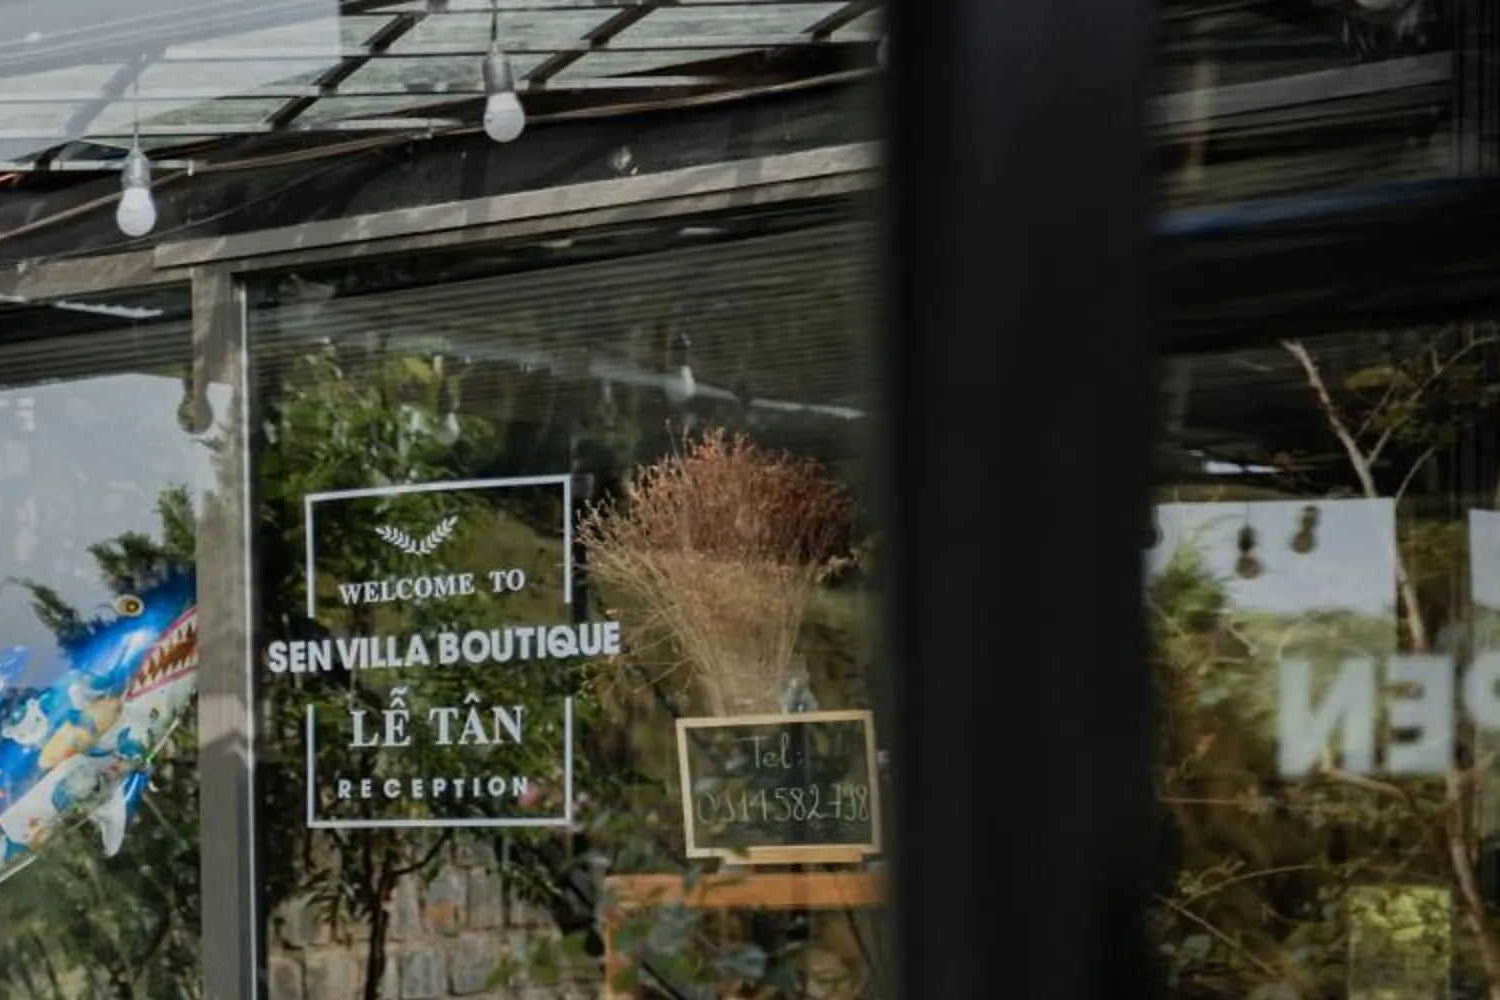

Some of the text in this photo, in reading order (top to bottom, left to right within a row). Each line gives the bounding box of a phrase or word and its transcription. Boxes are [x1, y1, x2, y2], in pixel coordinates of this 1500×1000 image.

[338, 568, 526, 605] WELCOME TO
[438, 622, 621, 664] BOUTIQUE
[349, 687, 525, 747] LỄ TÂN
[338, 776, 530, 800] RECEPTION
